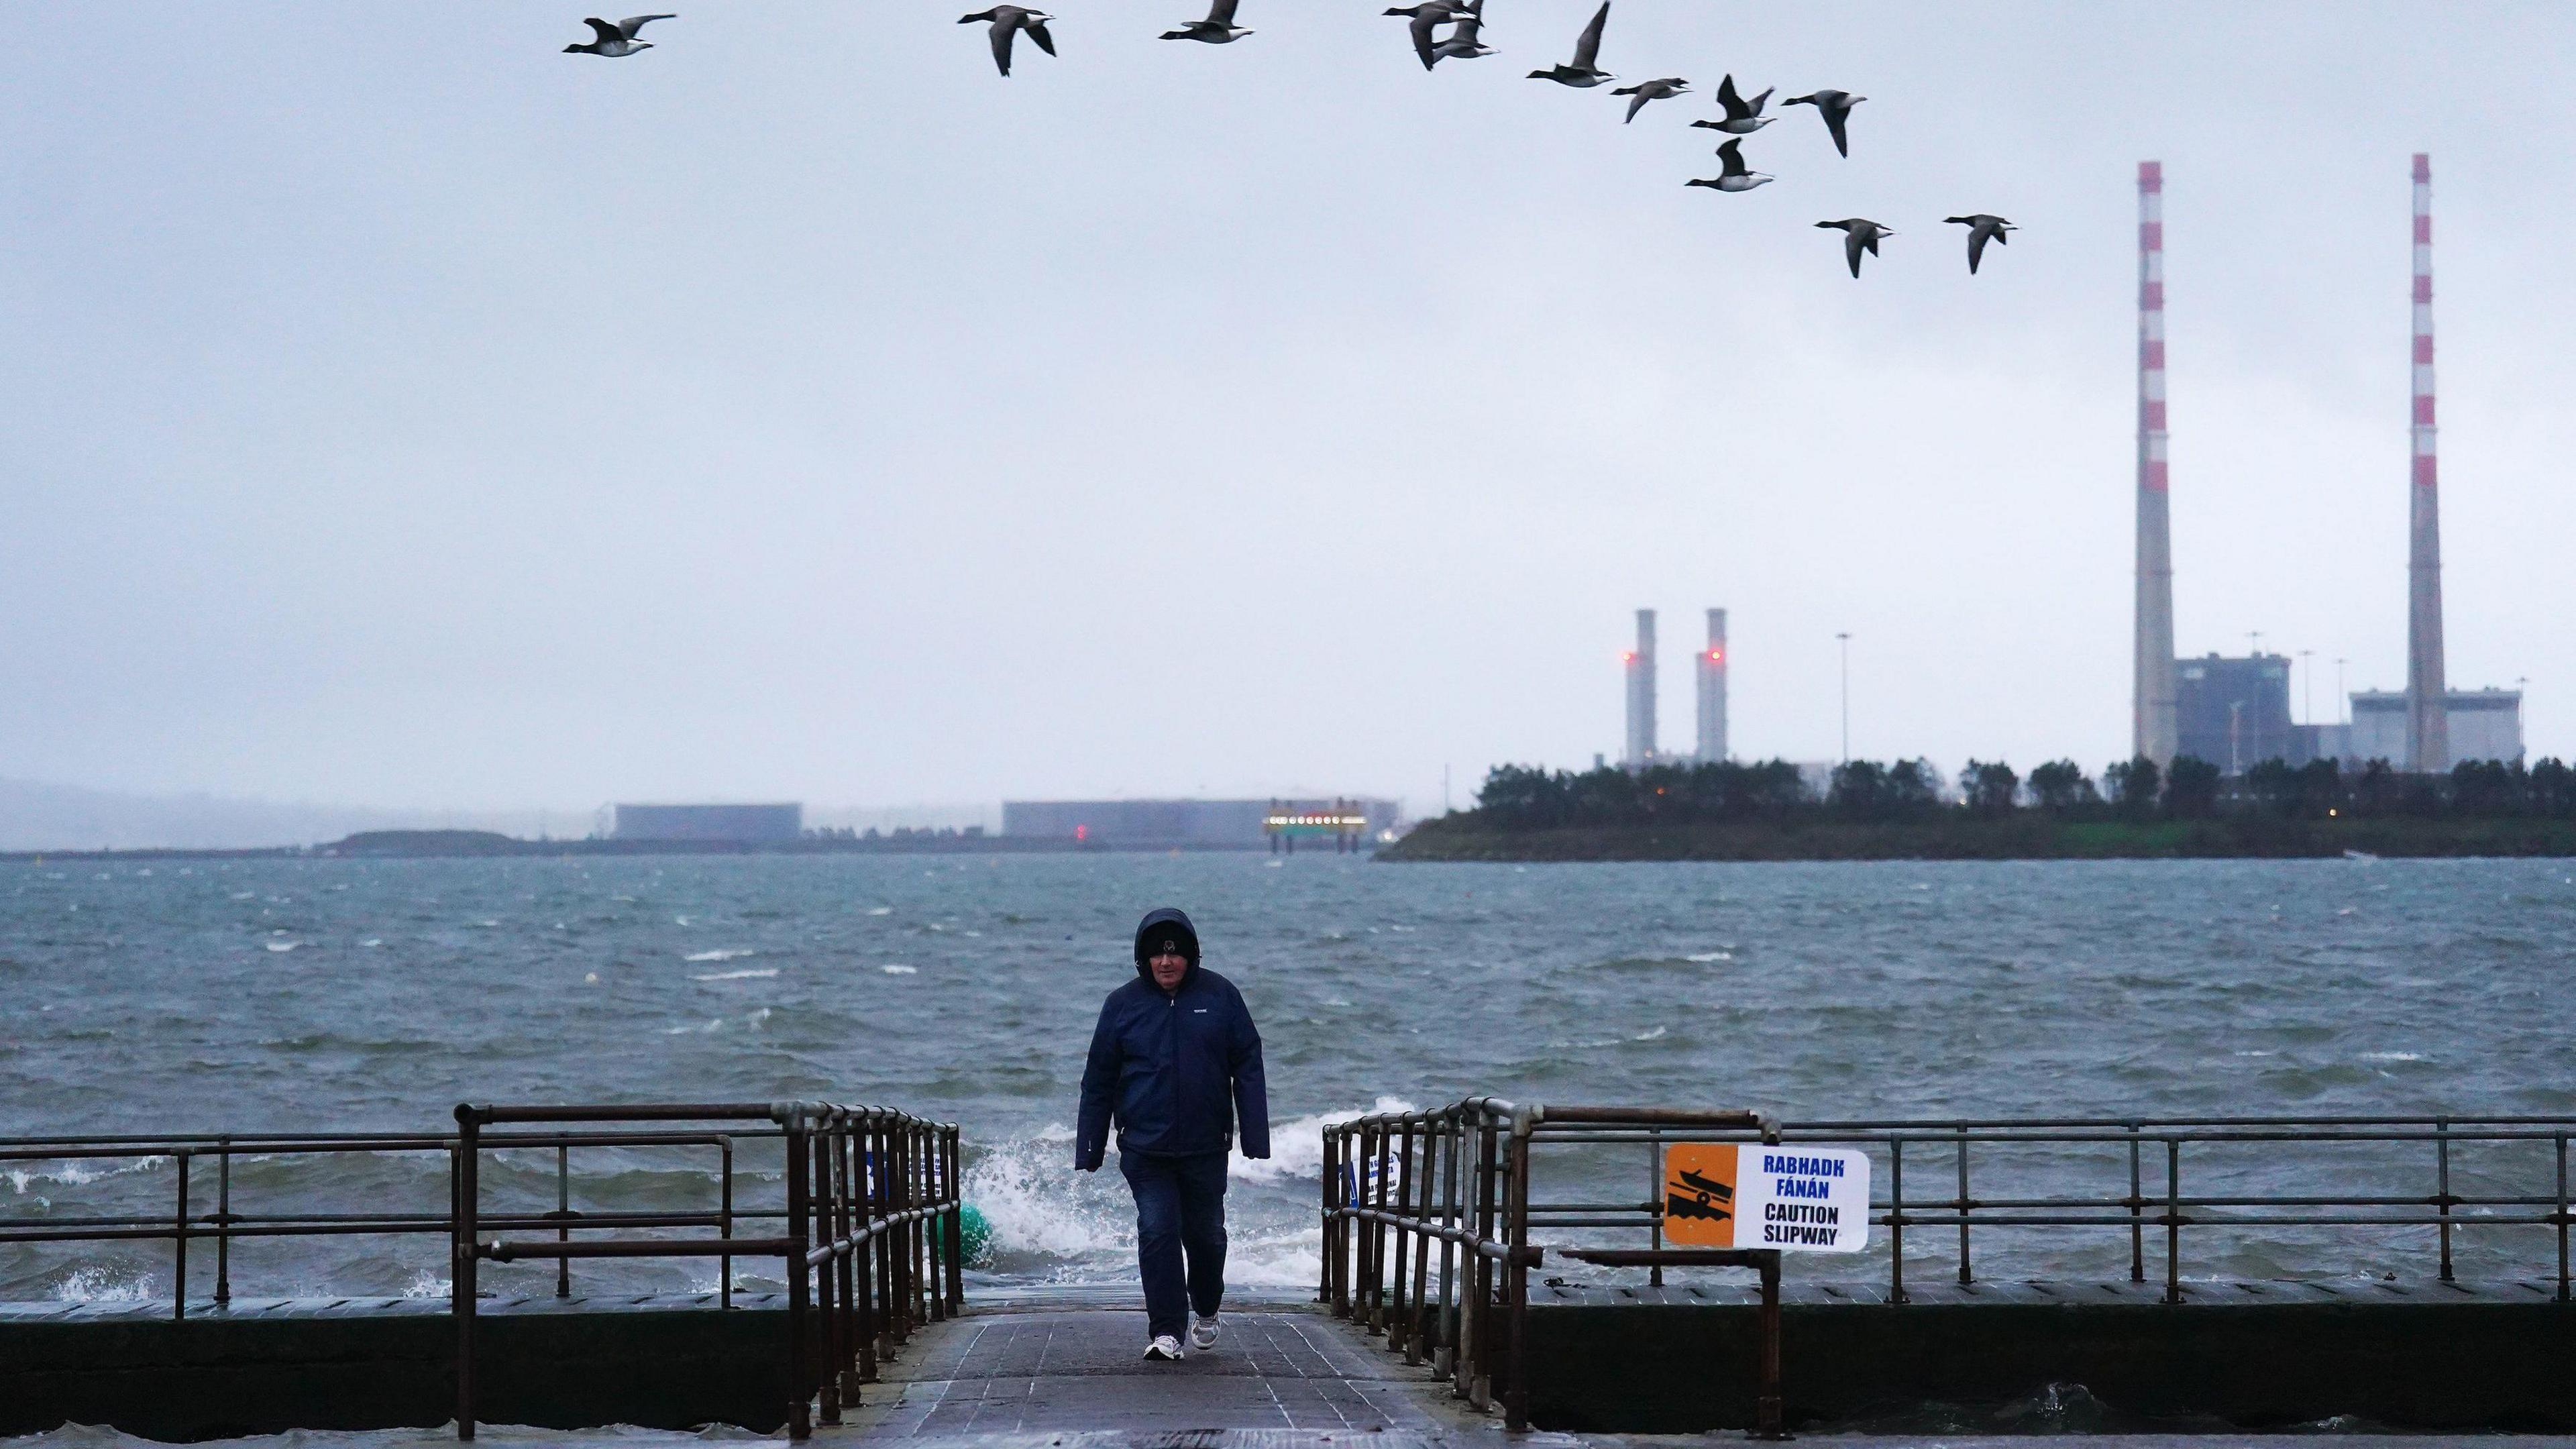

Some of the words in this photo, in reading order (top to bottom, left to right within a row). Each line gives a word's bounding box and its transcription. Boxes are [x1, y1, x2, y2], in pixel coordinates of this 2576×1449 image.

[1764, 1155, 1844, 1177] RABHADH
[1776, 1176, 1829, 1199] FÁNÁN
[1765, 1203, 1838, 1224] CAUTION
[1764, 1224, 1837, 1246] SLIPWAY
